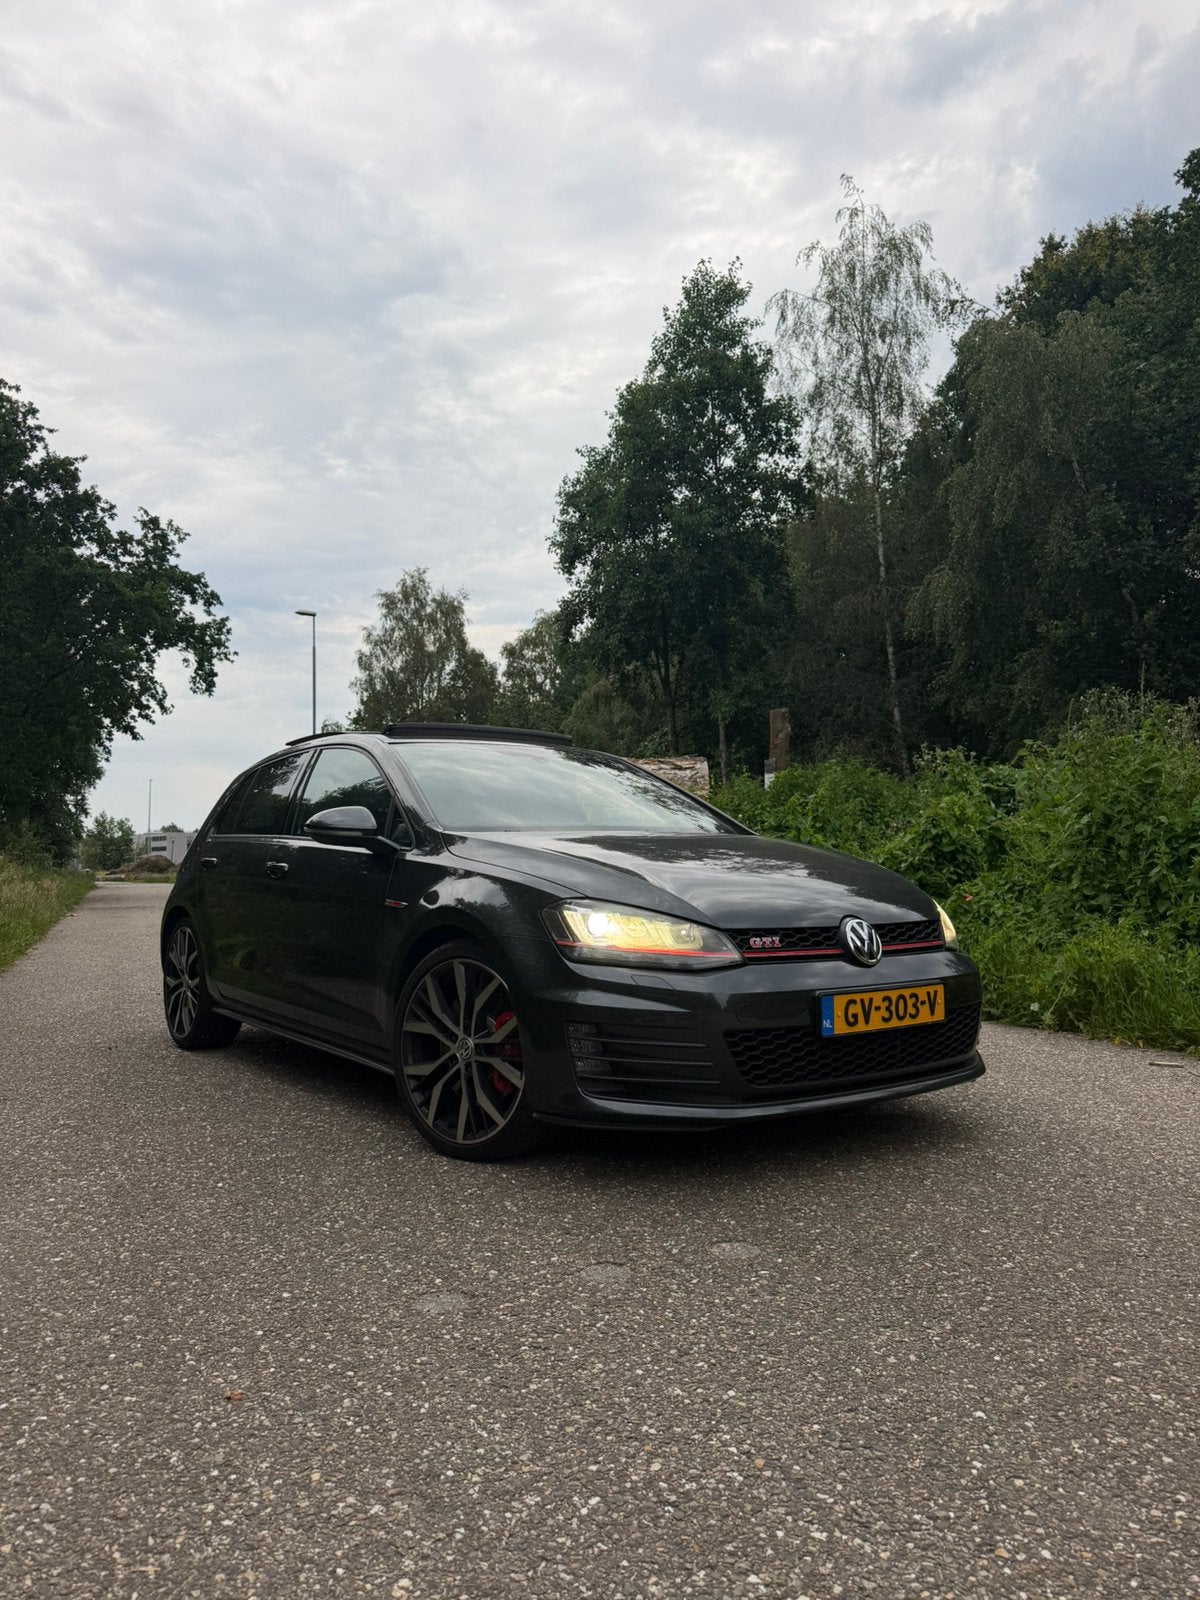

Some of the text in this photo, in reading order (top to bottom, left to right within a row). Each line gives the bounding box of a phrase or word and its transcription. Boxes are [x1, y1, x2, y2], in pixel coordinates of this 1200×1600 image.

[749, 936, 782, 948] GTI
[844, 990, 938, 1027] GV-303-V
[822, 1019, 833, 1028] NL
